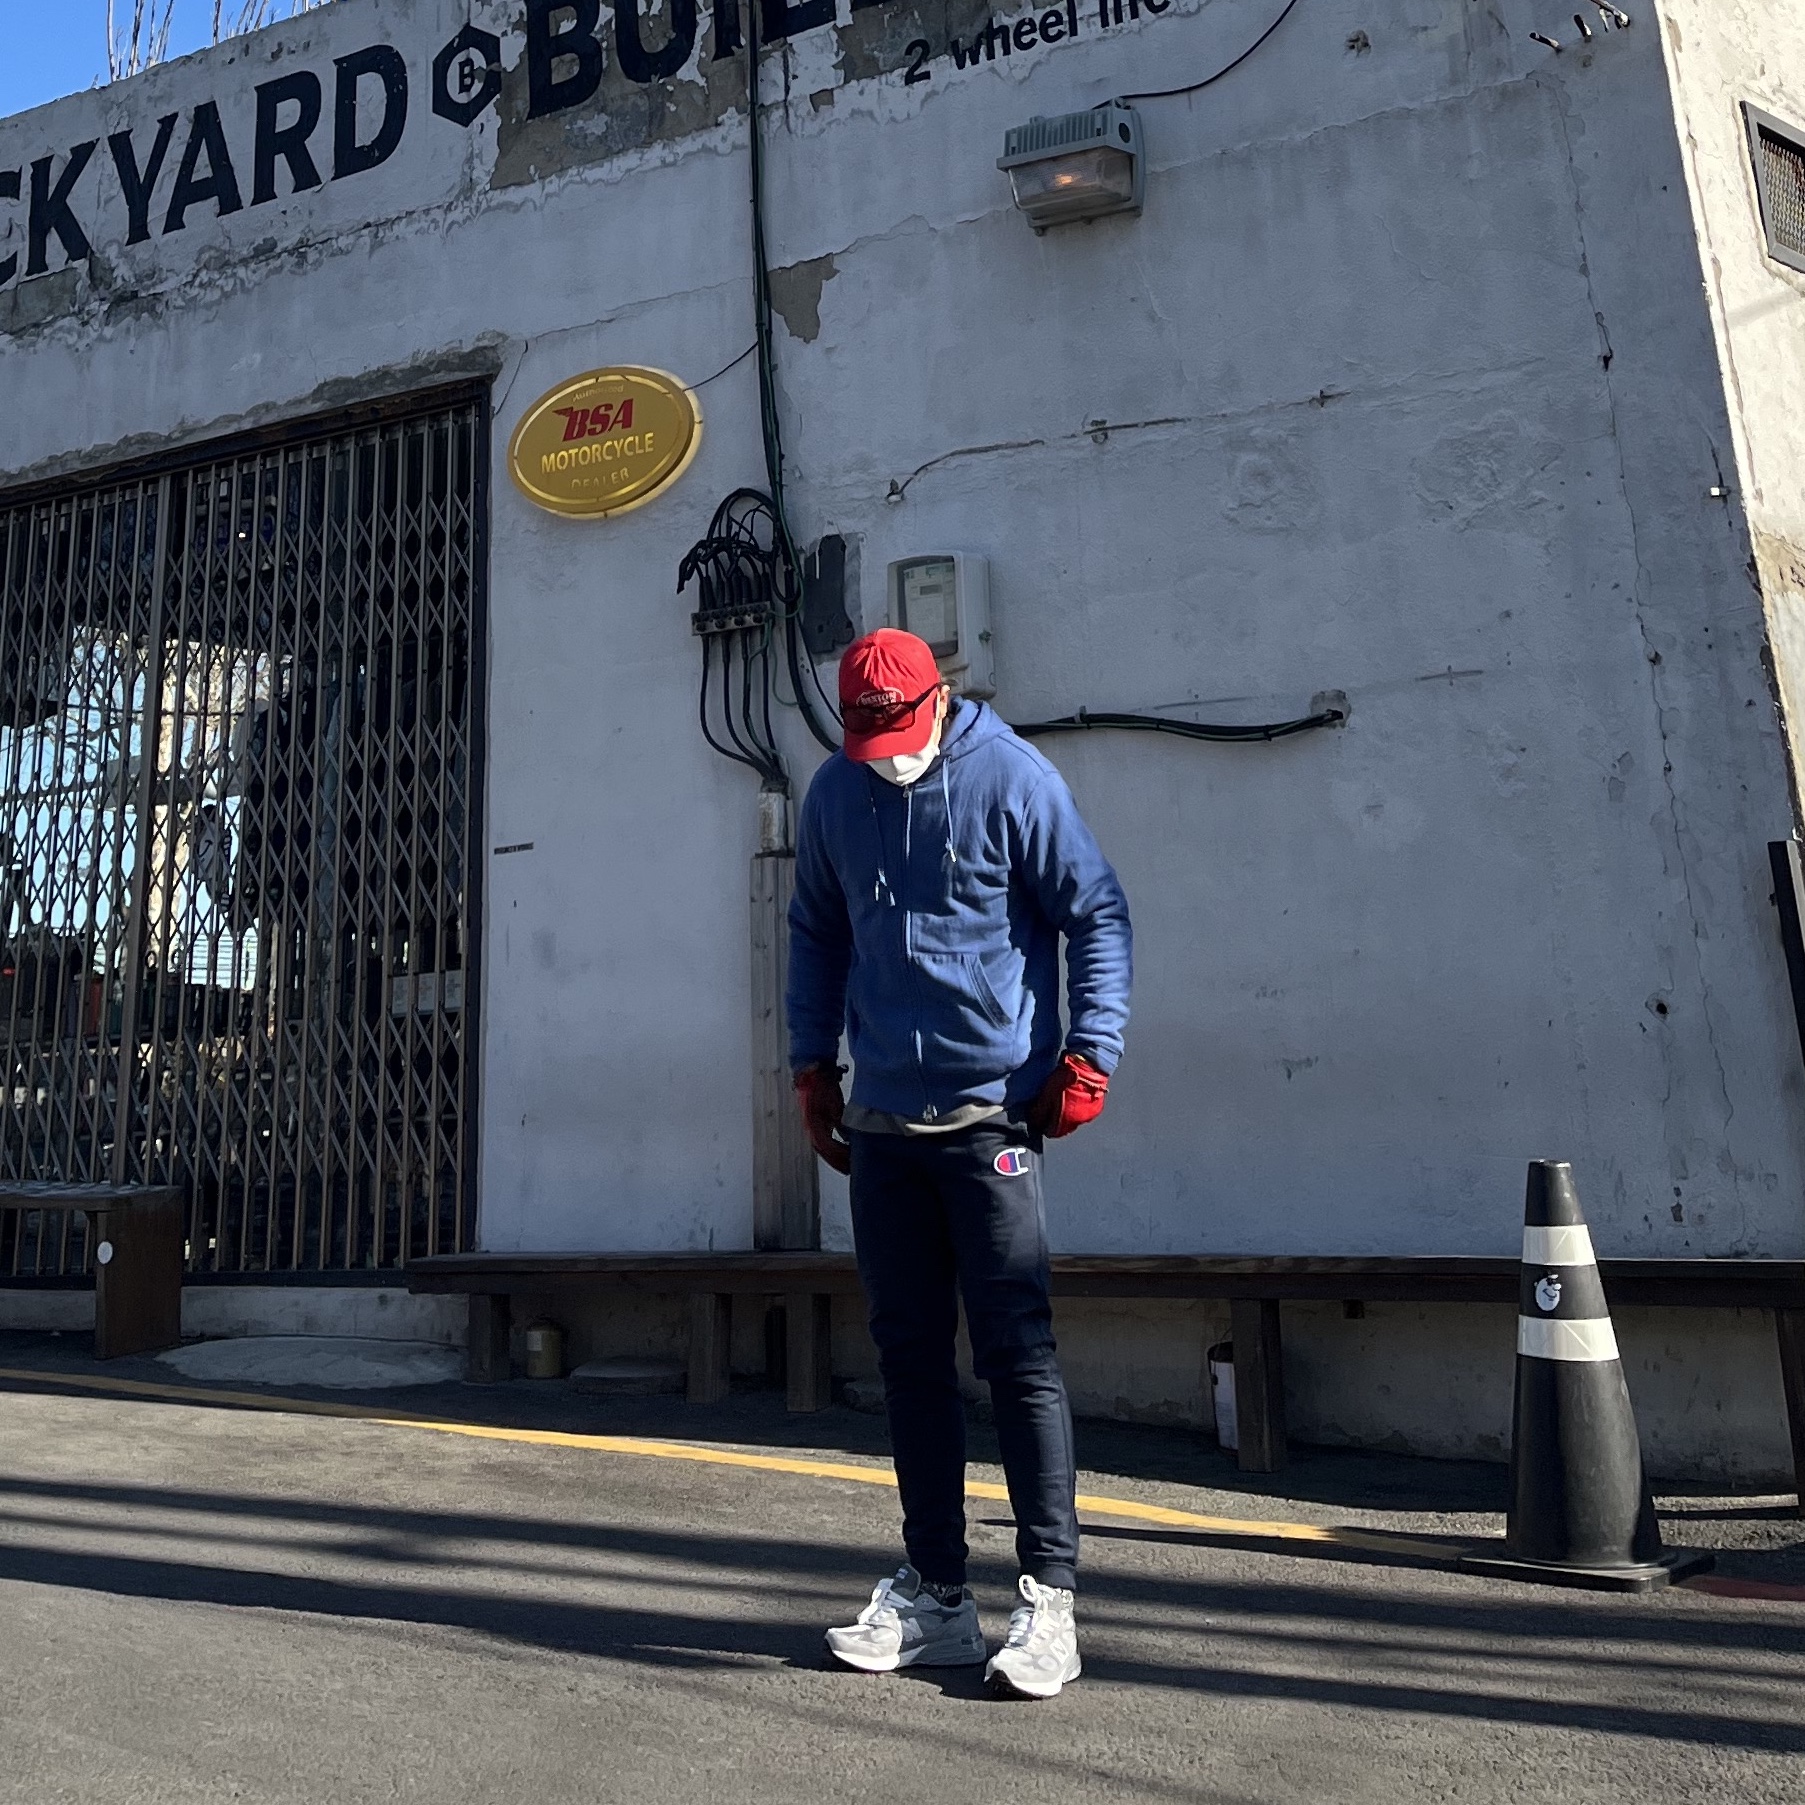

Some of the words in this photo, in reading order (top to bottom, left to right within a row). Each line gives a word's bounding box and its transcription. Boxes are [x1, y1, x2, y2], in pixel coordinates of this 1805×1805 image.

[905, 39, 931, 86] 2
[951, 0, 1079, 70] wheel
[554, 398, 634, 442] BSA
[541, 432, 655, 474] MOTORCYCLE
[571, 466, 630, 490] DEALER
